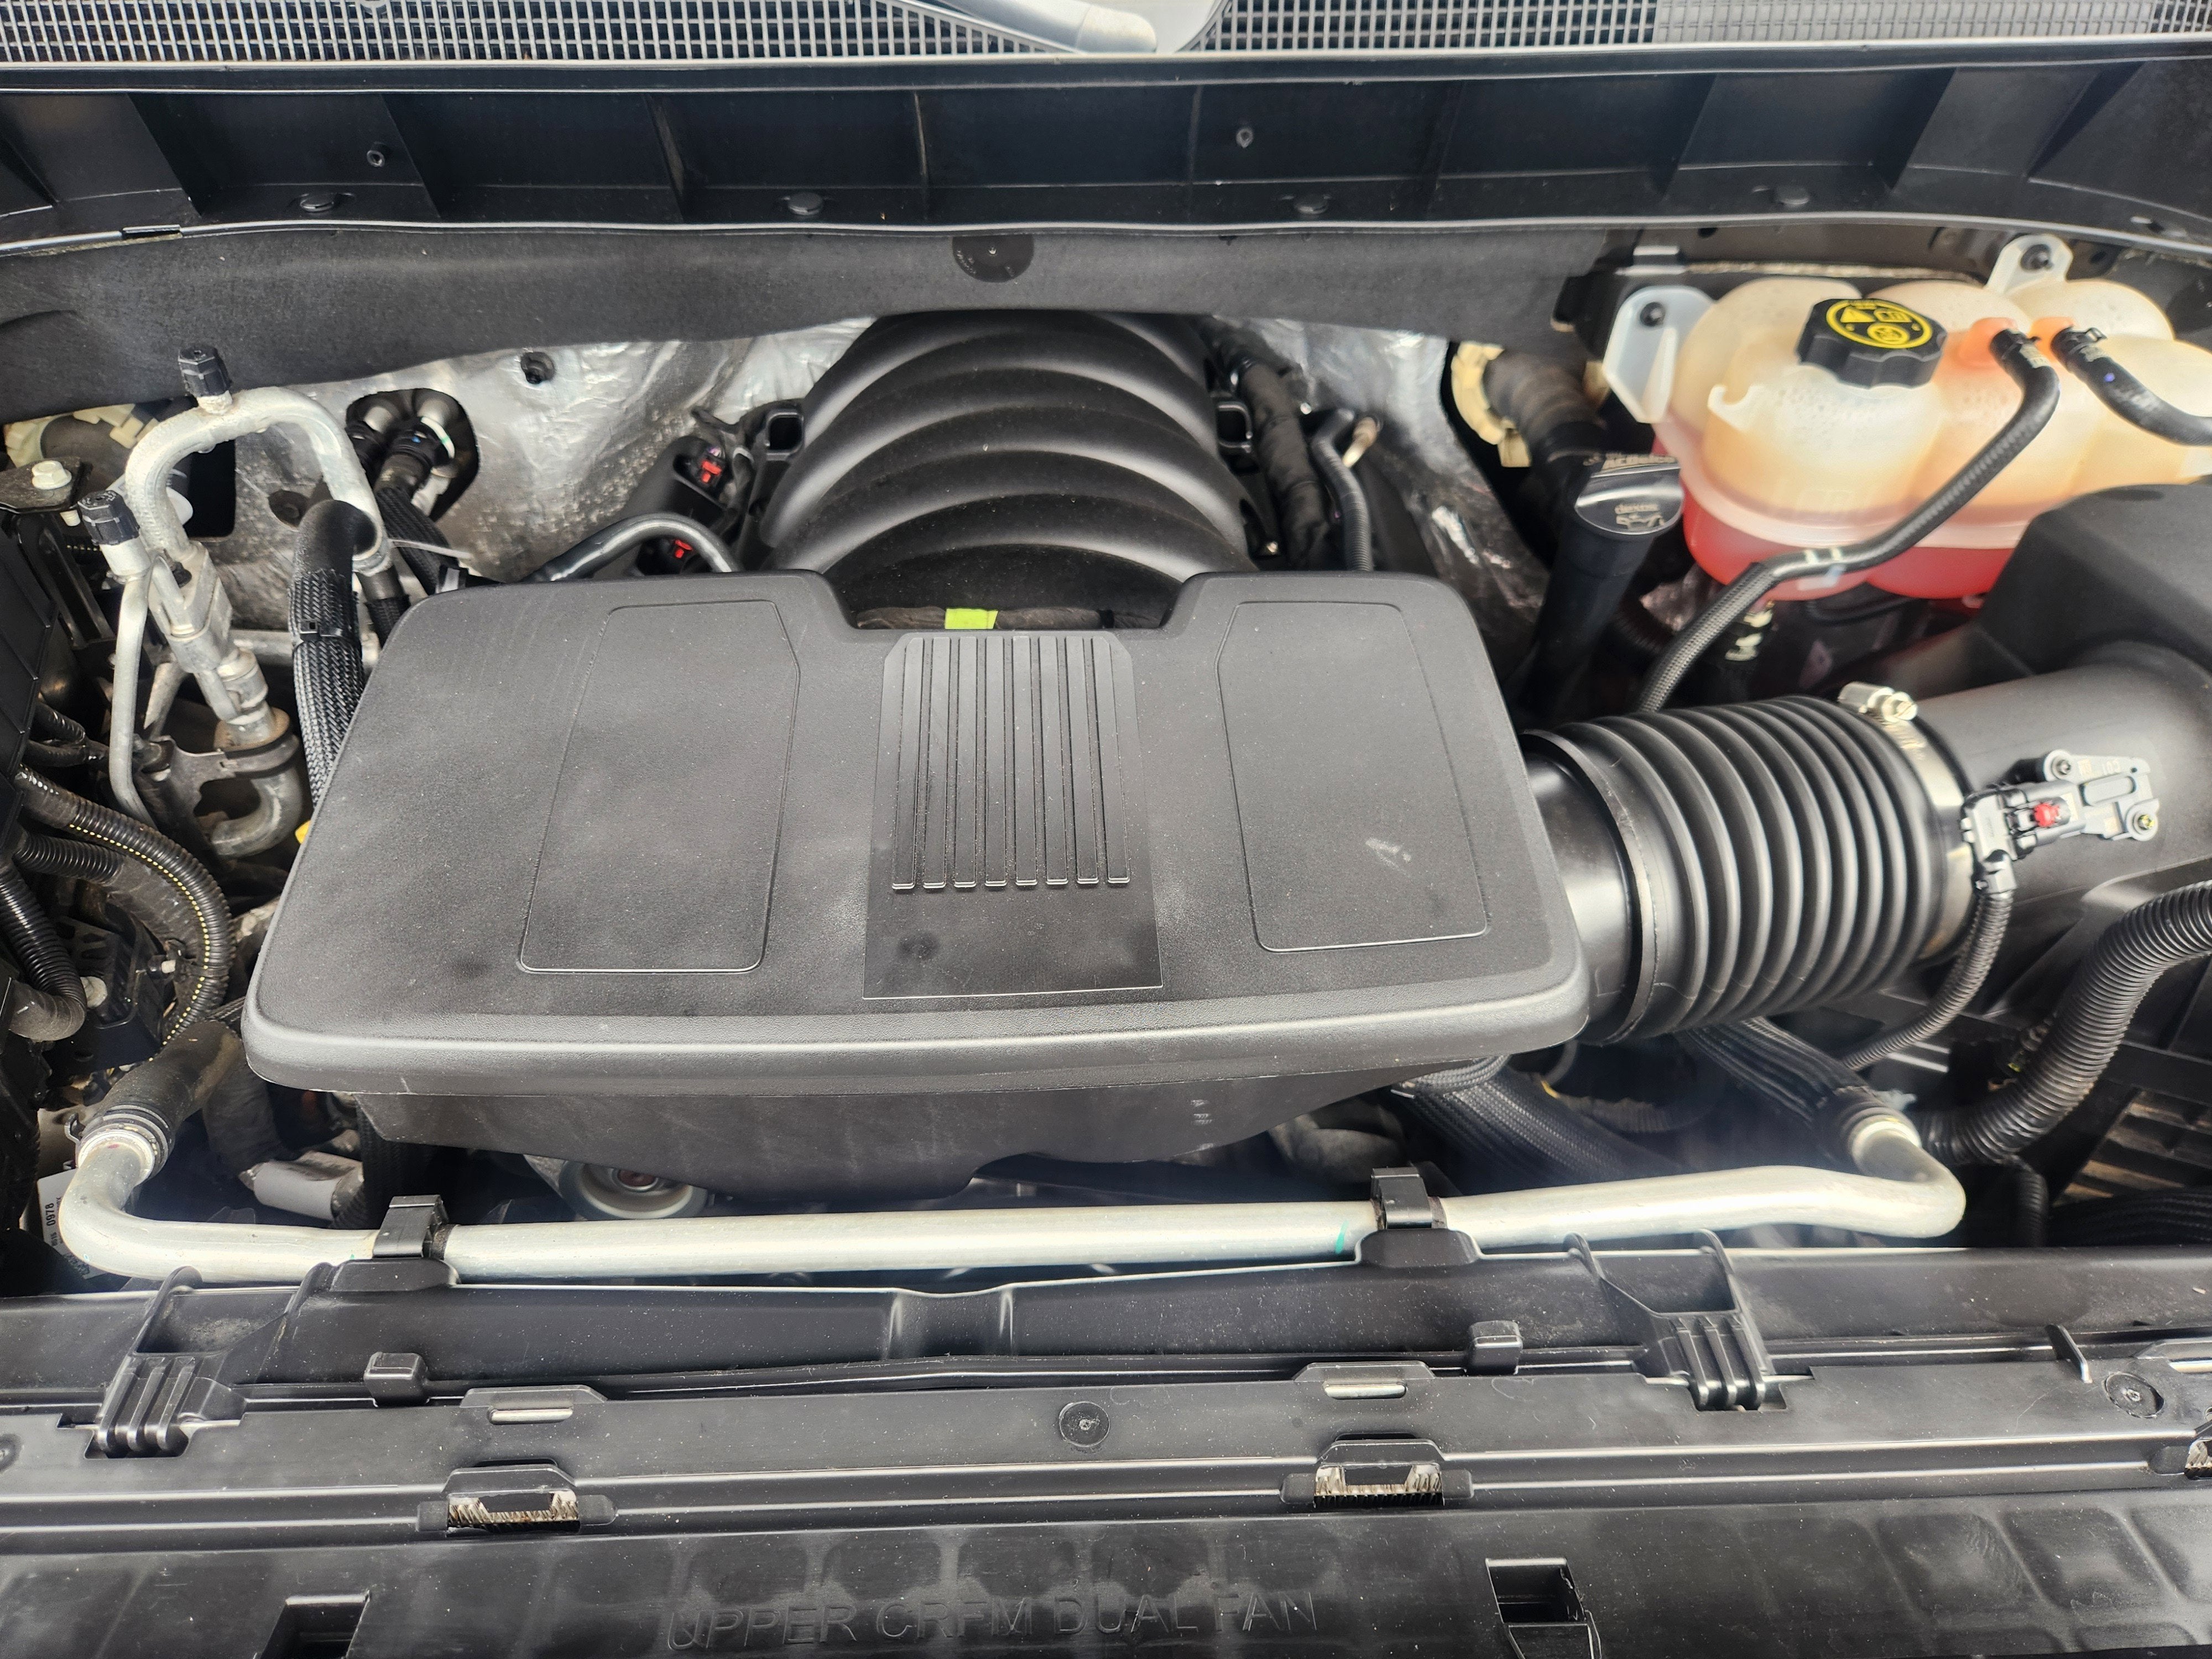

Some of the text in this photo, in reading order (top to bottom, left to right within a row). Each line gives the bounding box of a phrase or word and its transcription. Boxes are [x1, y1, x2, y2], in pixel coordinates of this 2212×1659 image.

[45, 1203, 56, 1226] 0978
[667, 1592, 1317, 1650] UPPER CRFM DUAL FAN
